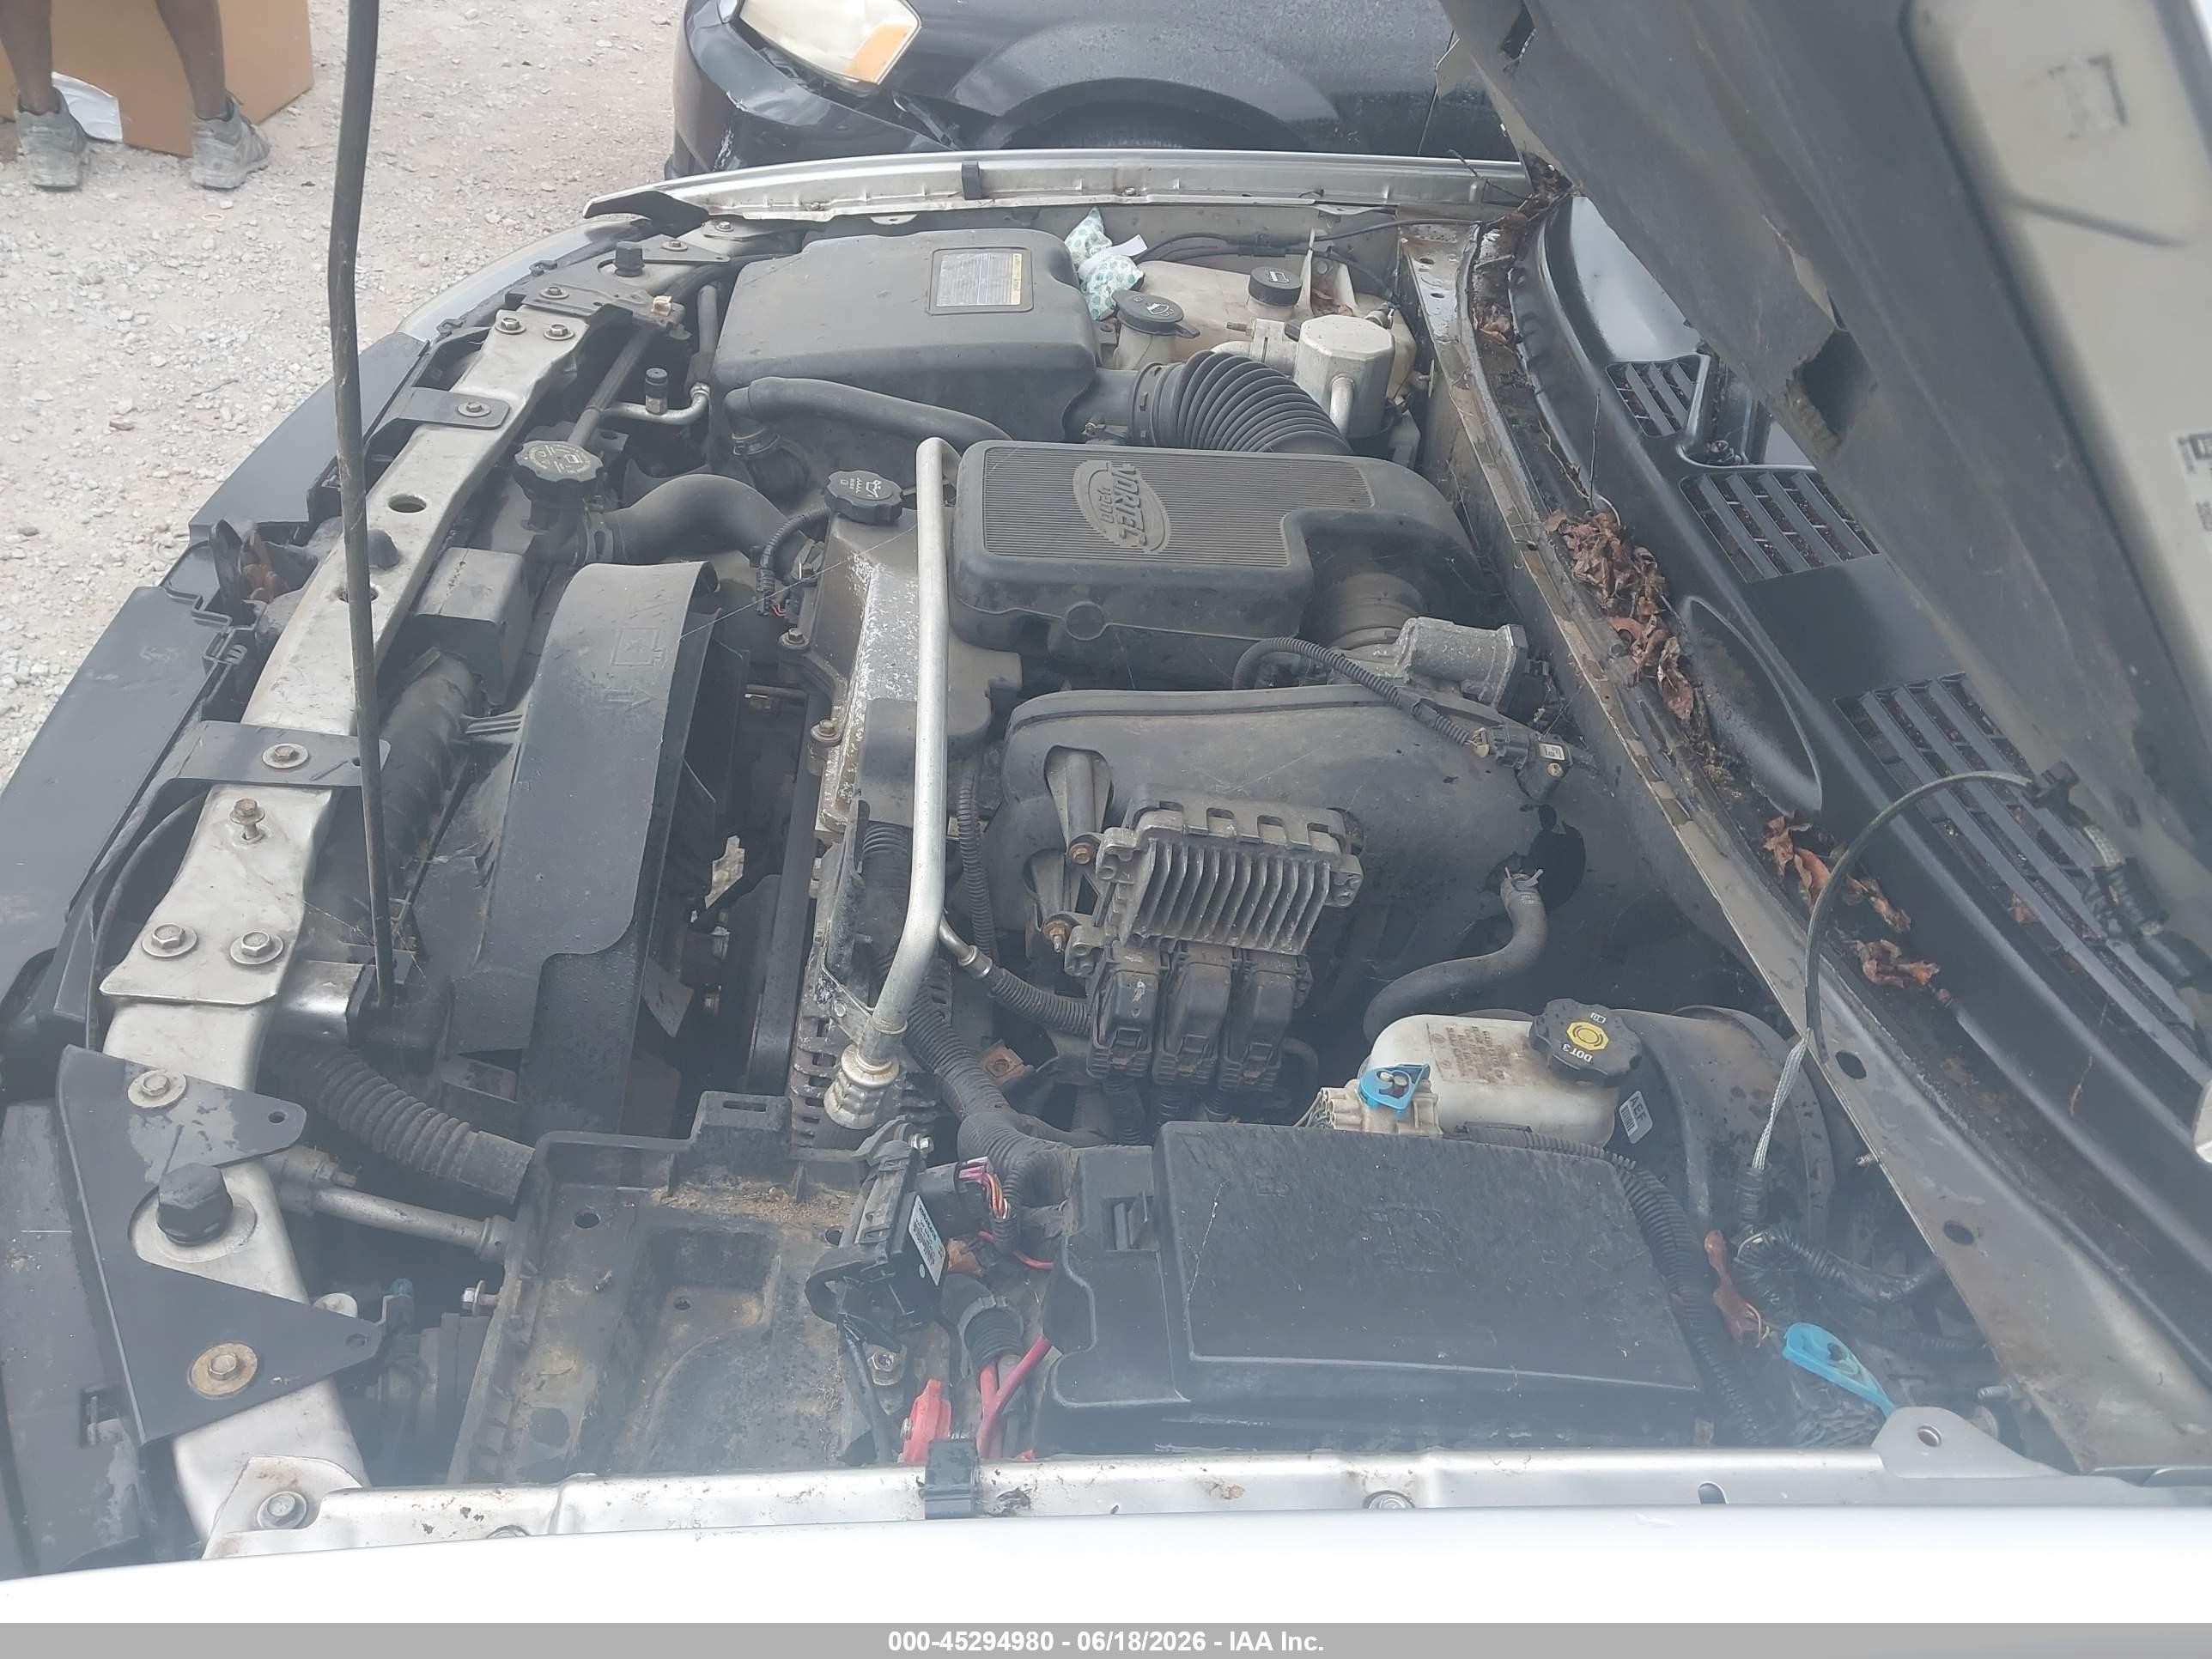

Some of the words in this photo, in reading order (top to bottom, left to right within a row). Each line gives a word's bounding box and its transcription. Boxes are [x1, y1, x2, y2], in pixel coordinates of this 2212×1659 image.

[1111, 465, 1147, 546] VORTEC
[1562, 1043, 1571, 1053] 3
[1571, 1048, 1593, 1062] DOT
[1632, 1097, 1645, 1121] AEF
